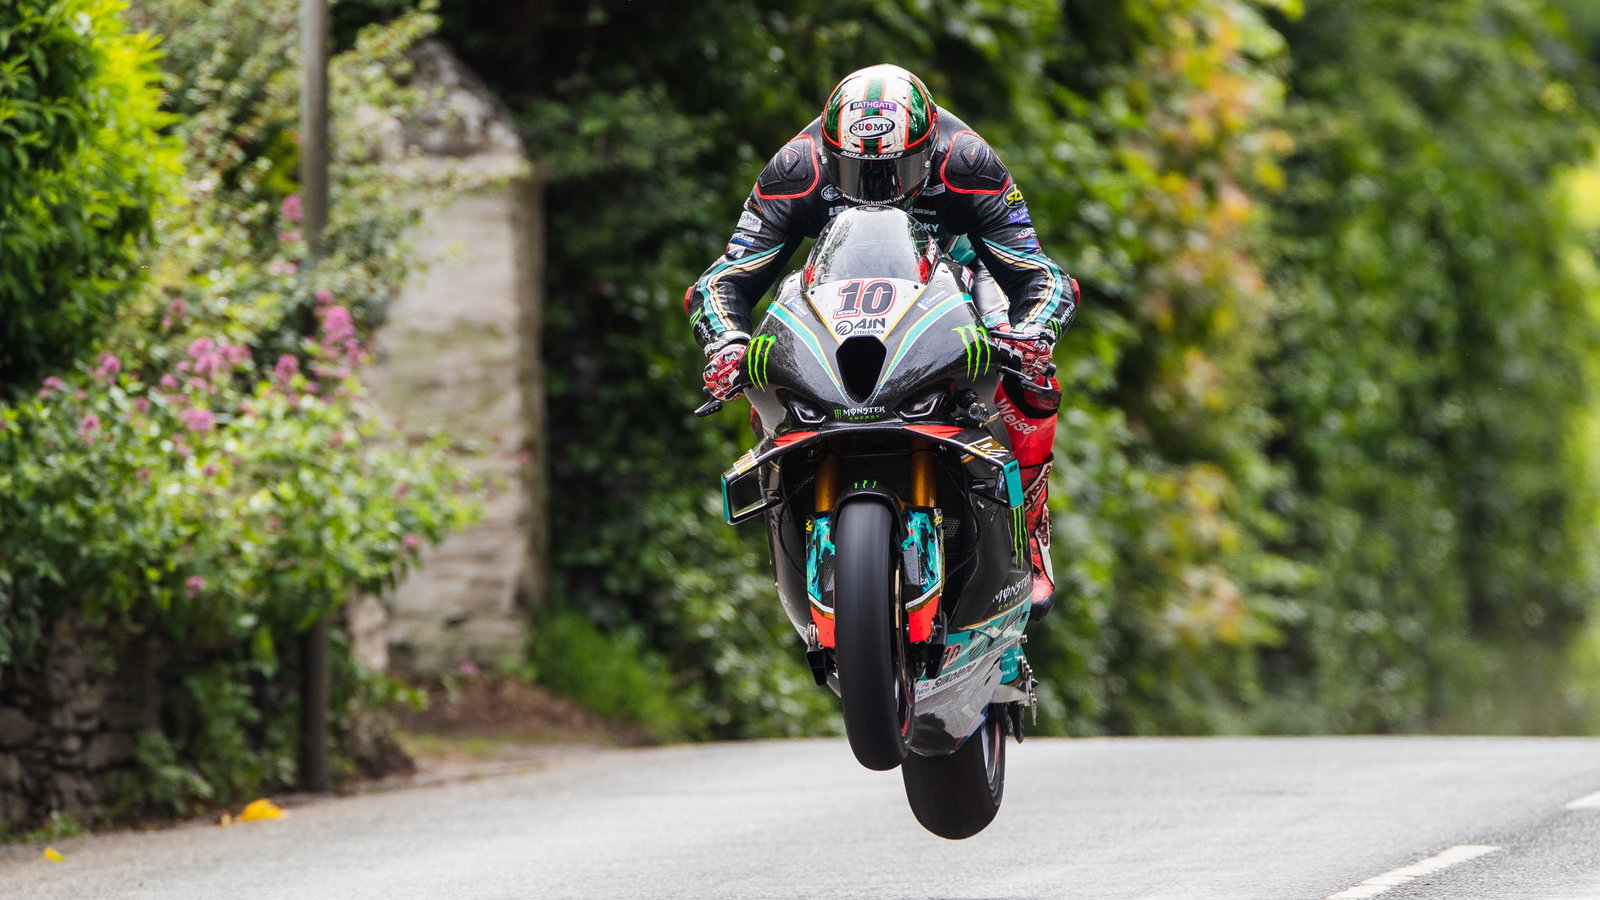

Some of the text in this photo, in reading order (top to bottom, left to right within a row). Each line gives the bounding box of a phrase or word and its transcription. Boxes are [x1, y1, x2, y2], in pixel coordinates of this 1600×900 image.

[852, 101, 894, 110] BATHGATE
[852, 123, 892, 132] SUOMY
[840, 150, 878, 160] NOLAN
[833, 279, 897, 319] 10
[843, 406, 886, 417] MONSTER
[995, 397, 1038, 435] Weise
[943, 642, 963, 669] 10
